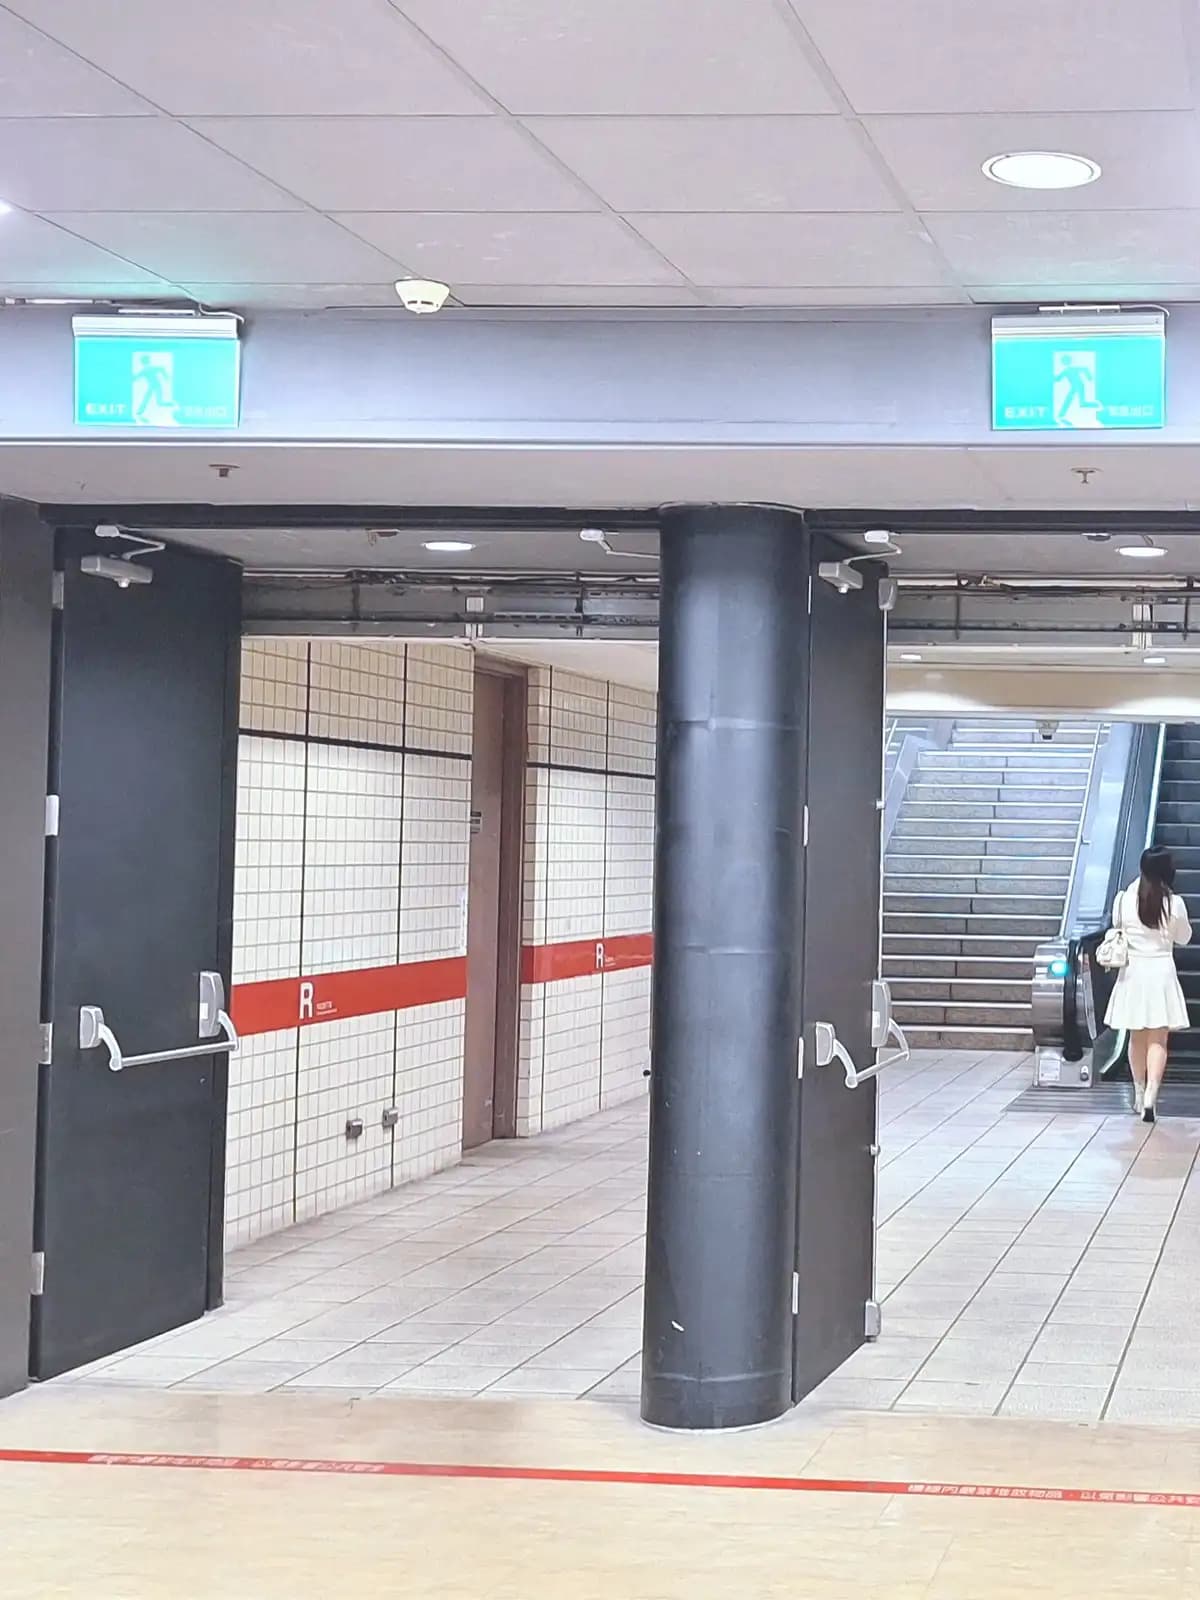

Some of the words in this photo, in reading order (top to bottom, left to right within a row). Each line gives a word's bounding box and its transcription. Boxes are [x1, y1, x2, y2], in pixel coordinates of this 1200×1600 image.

[85, 403, 126, 416] EXIT
[1004, 406, 1047, 419] EXIT
[596, 943, 604, 969] R
[299, 982, 313, 1019] R
